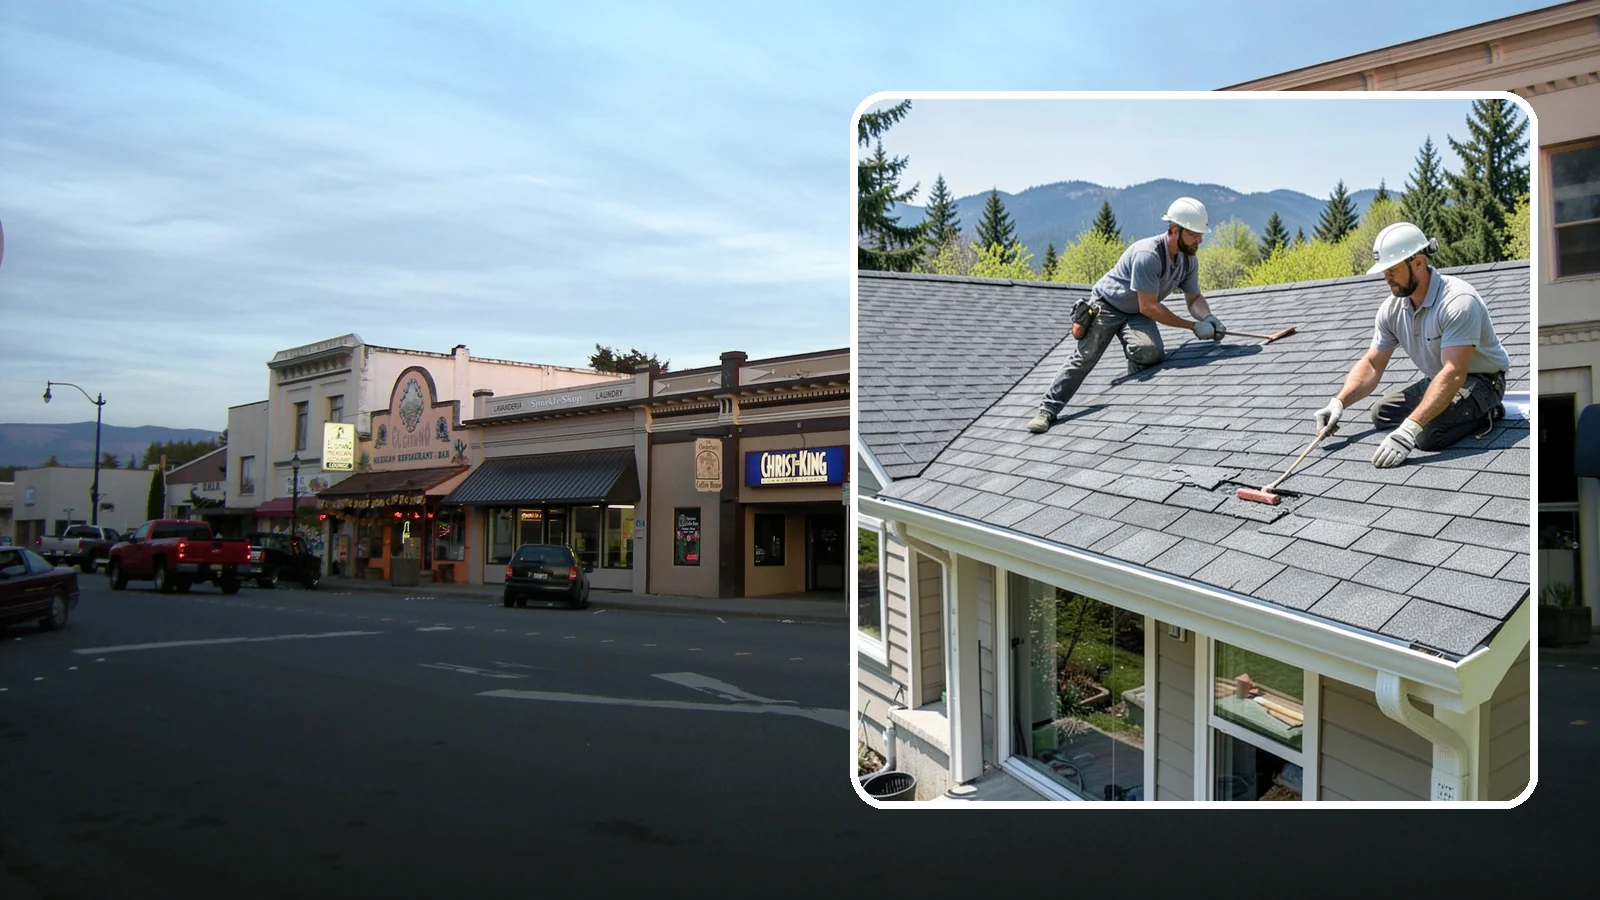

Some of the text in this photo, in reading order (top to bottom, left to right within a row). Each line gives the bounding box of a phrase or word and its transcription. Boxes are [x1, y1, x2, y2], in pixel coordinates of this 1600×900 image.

[530, 394, 583, 409] Sparkle Shop
[595, 389, 624, 400] LAUNDRY
[493, 402, 523, 413] LAVANDERIA
[373, 450, 450, 464] MEXICAN RESTAURANT BAR
[799, 450, 827, 476] KING
